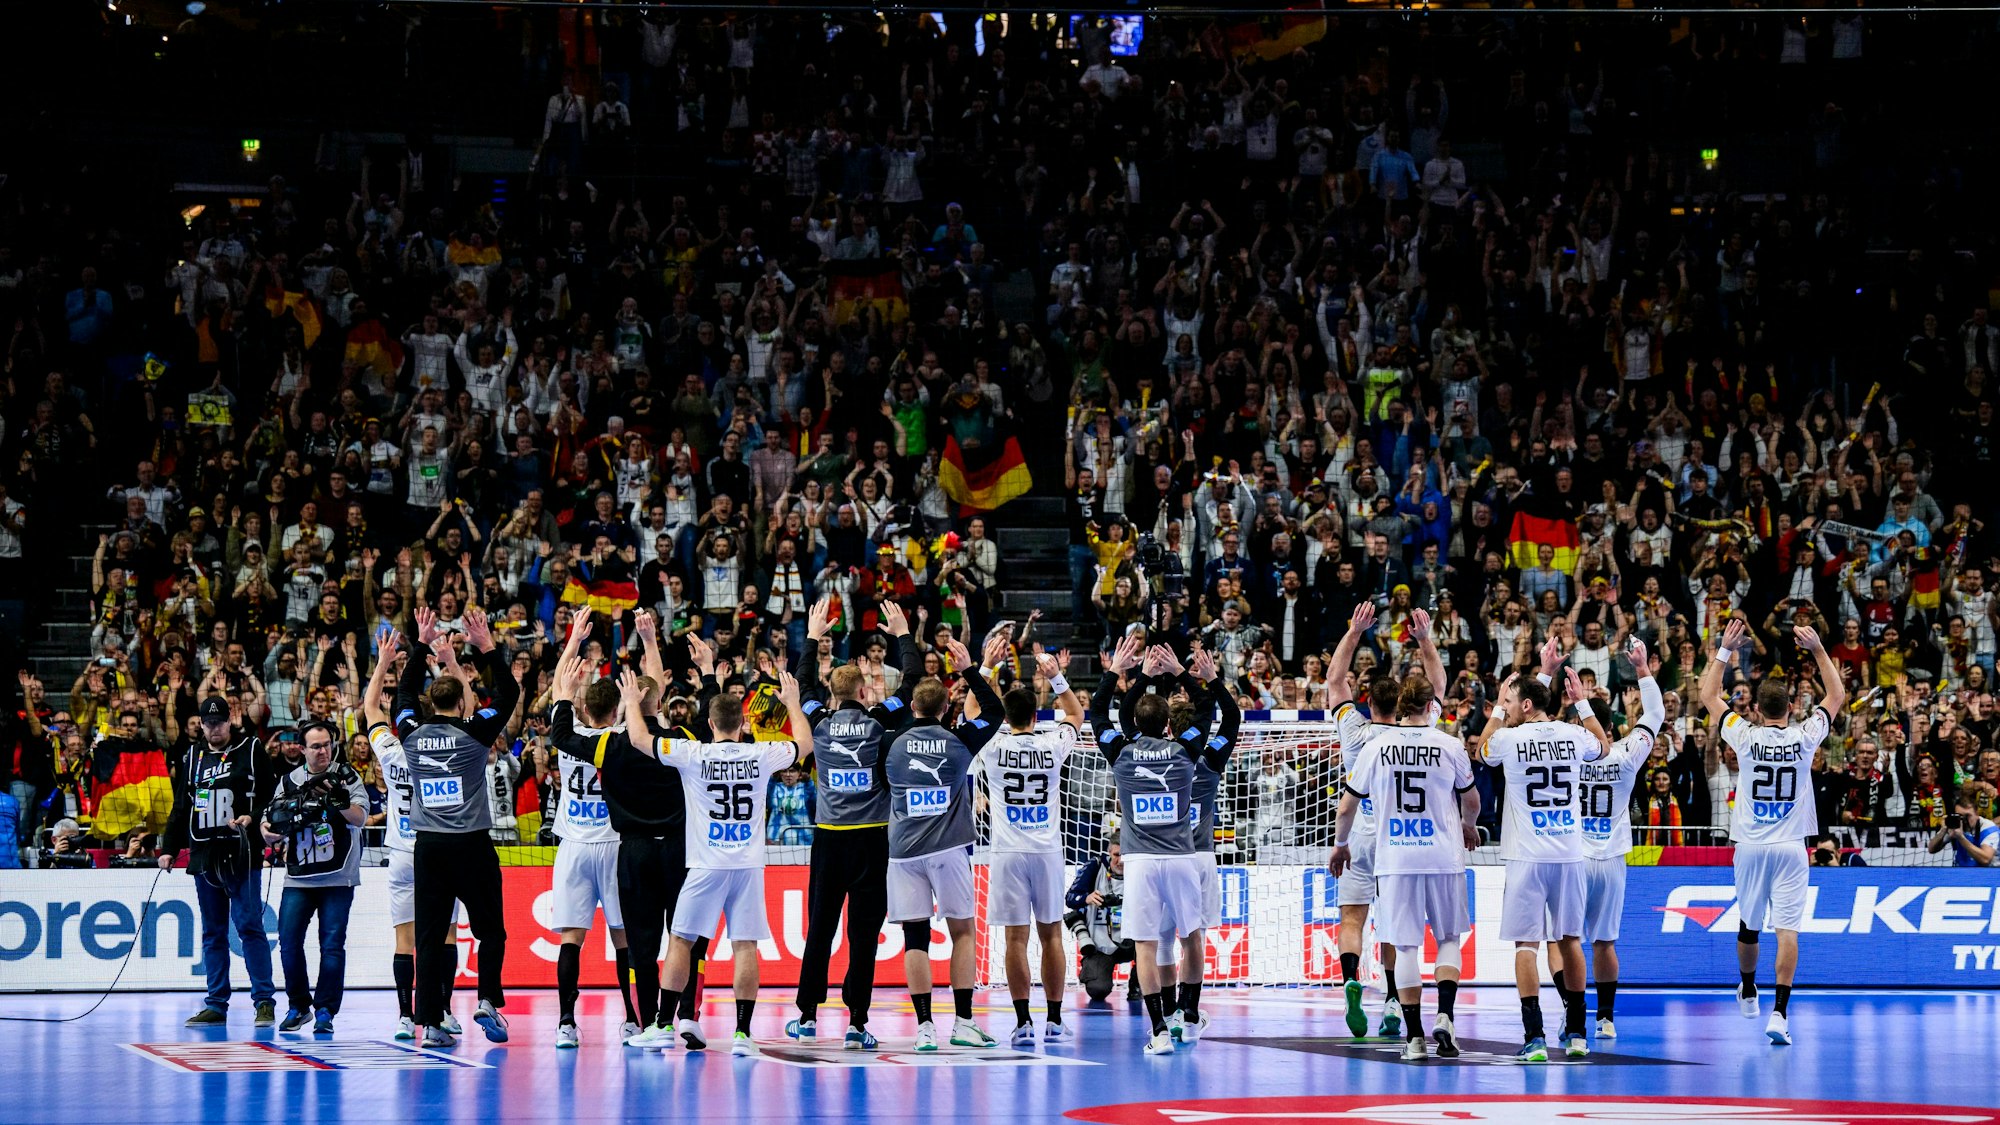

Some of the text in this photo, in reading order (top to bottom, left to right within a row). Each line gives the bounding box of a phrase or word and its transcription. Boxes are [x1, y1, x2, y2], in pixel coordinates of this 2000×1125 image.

[829, 723, 865, 736] GERMANY
[417, 736, 457, 751] GERMANY
[906, 739, 947, 753] GERMANY
[1516, 739, 1577, 763] HÄFNER
[1751, 742, 1803, 762] WEBER
[998, 748, 1054, 769] USCINS
[1132, 747, 1171, 761] GERMANY
[1380, 745, 1441, 767] KNORR
[701, 759, 760, 780] MERTENS
[423, 780, 459, 797] DKB
[832, 772, 869, 787] DKB
[1003, 772, 1049, 805] 23
[1525, 765, 1572, 807] 25
[1752, 765, 1797, 801] 20
[707, 783, 753, 820] 36
[910, 790, 947, 806] DKB
[1394, 771, 1427, 813] 15
[568, 799, 609, 818] DKB
[1007, 805, 1049, 823] DKB
[1136, 796, 1174, 813] DKB
[1390, 818, 1434, 837] DKB
[1531, 809, 1575, 828] DKB
[708, 822, 752, 841] DKB
[1661, 885, 2000, 934] FALKE
[1952, 945, 2000, 970] TY
